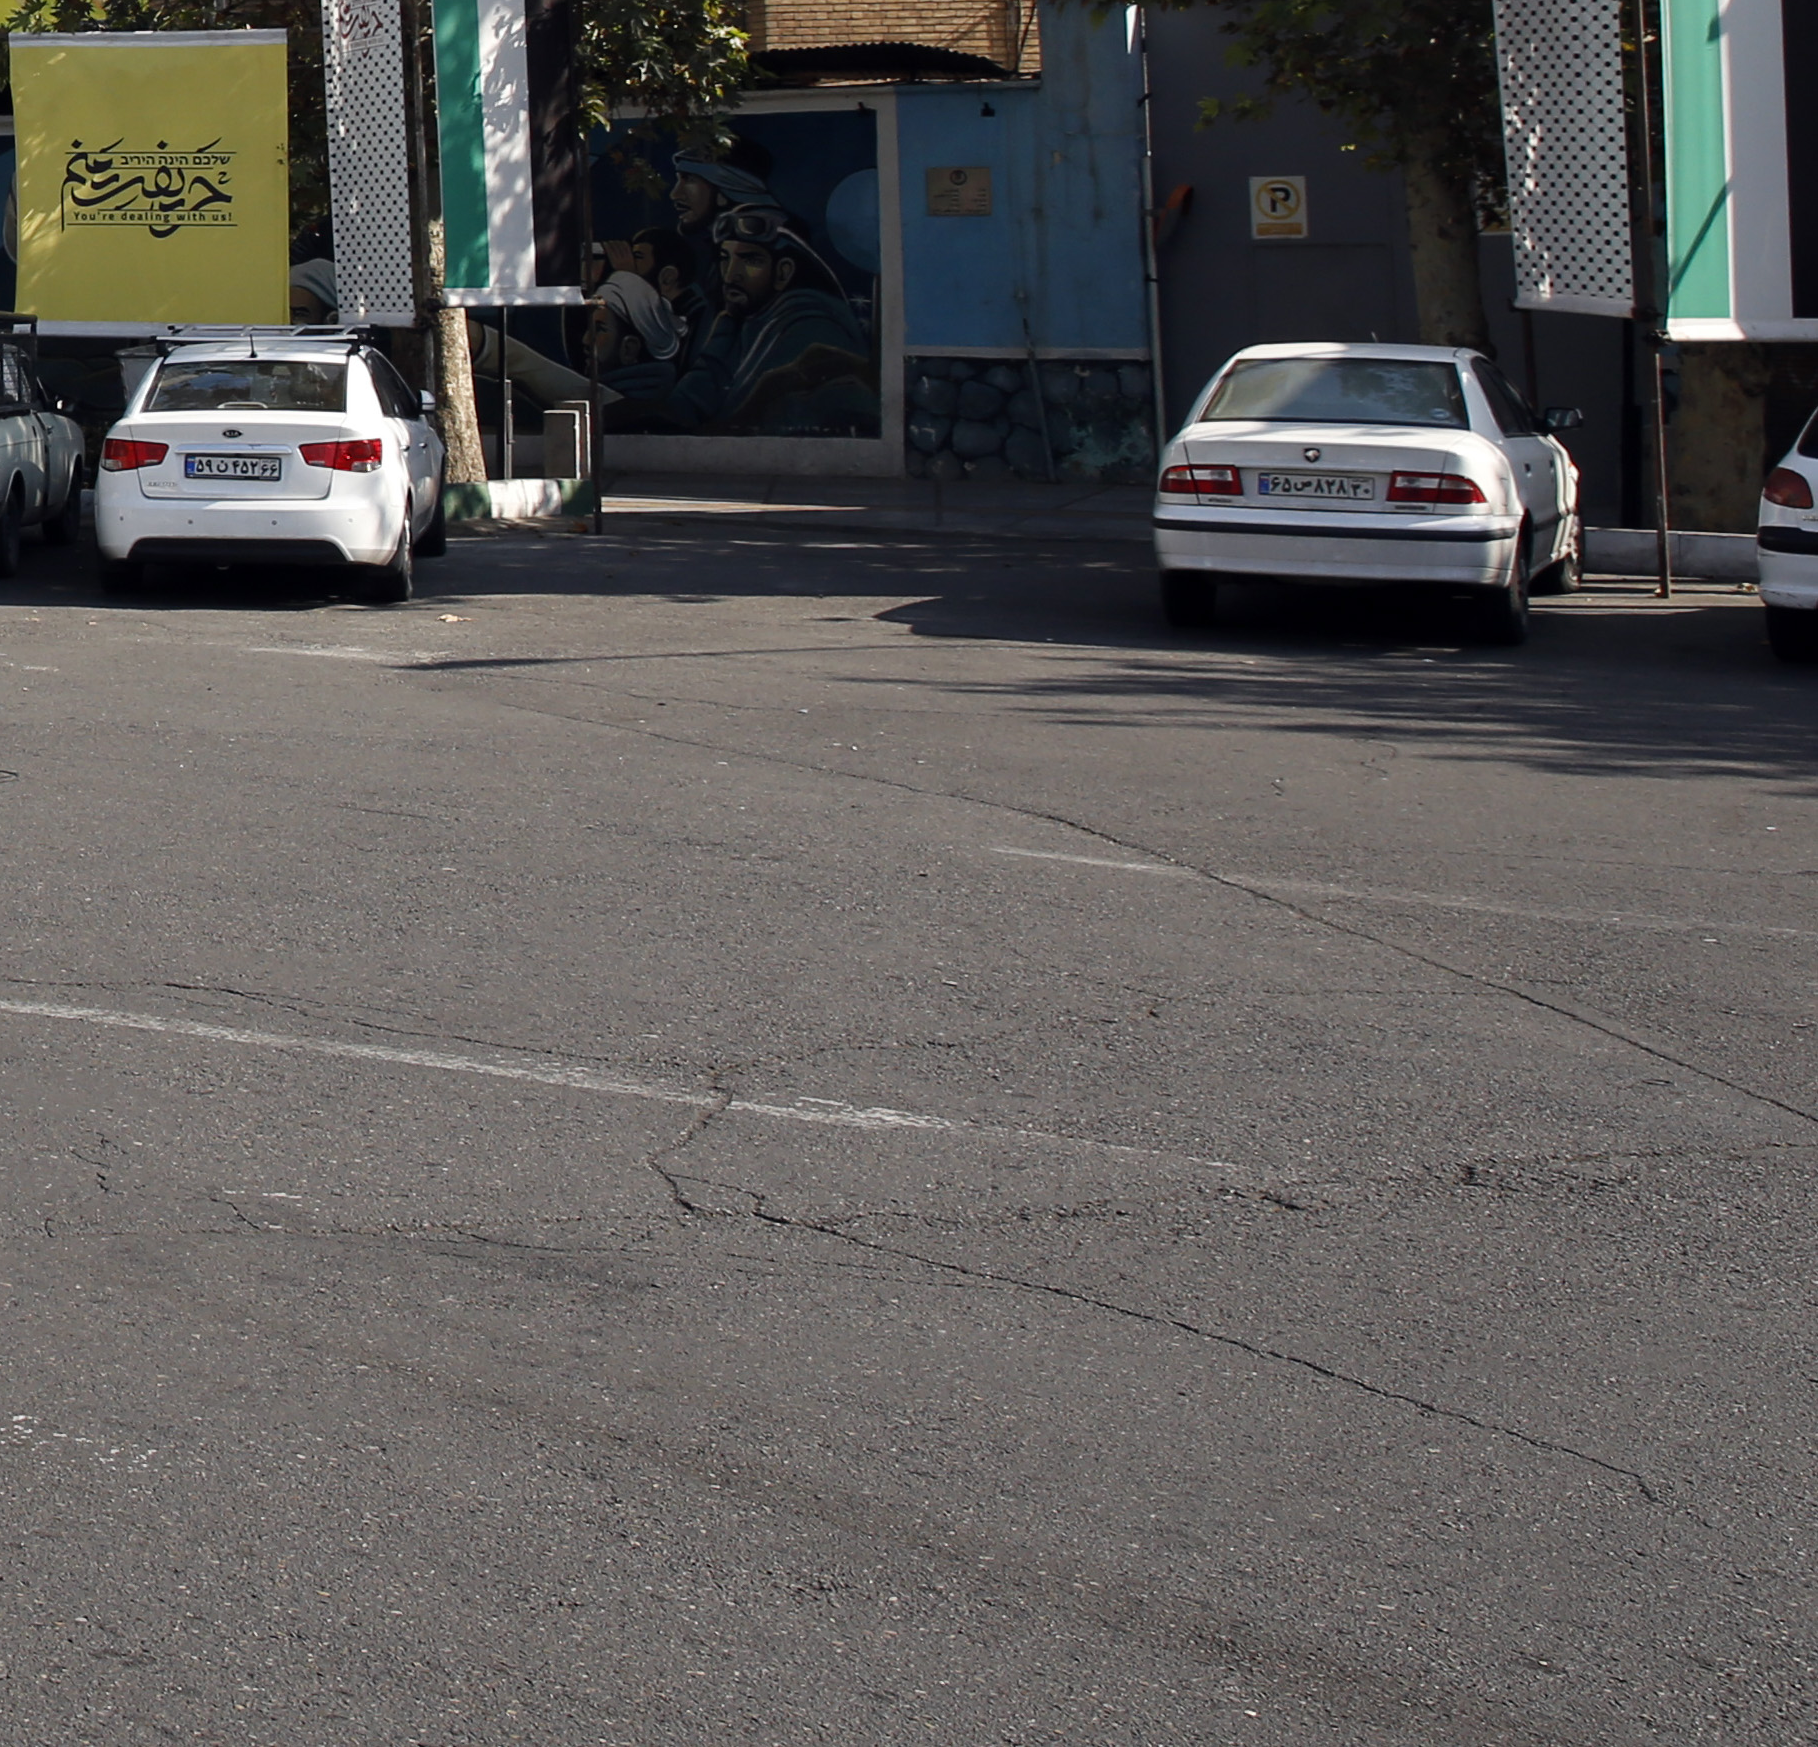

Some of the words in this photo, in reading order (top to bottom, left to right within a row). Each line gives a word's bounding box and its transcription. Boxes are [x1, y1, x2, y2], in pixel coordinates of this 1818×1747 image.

[120, 155, 156, 166] היריב
[158, 155, 189, 166] הינה
[193, 155, 231, 166] שלכם
[73, 212, 115, 222] You're
[120, 211, 170, 224] dealing
[176, 212, 206, 222] with
[212, 212, 233, 222] us!
